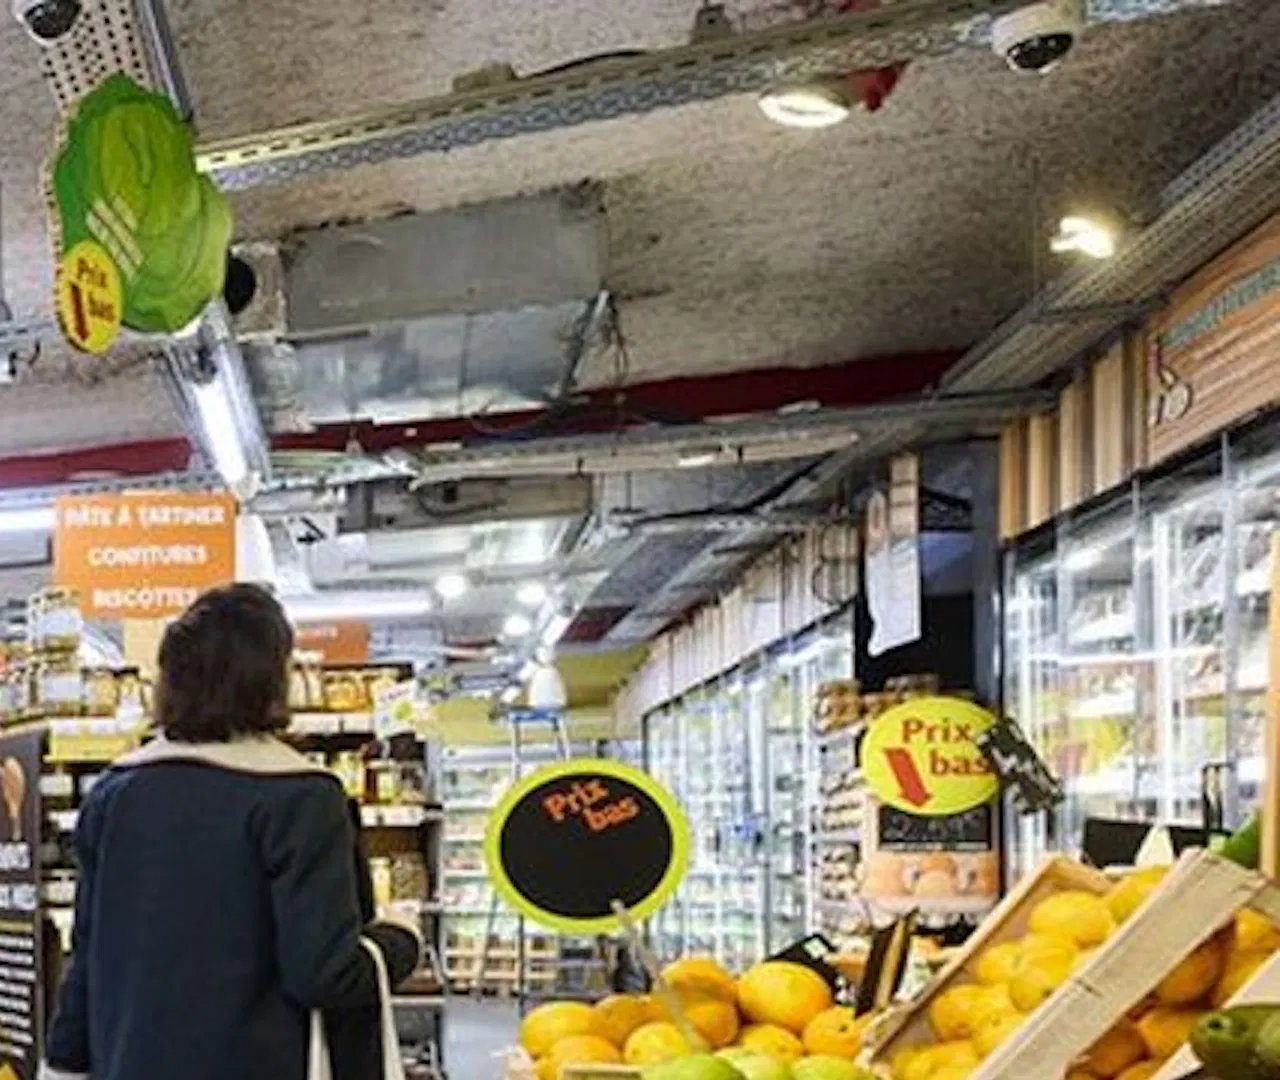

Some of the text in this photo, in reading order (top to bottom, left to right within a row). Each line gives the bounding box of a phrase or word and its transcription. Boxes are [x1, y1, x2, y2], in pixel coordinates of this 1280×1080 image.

[137, 505, 226, 526] TARTINER
[88, 545, 207, 566] CONFITURES
[901, 716, 973, 744] Prix
[928, 748, 991, 777] bas
[542, 777, 611, 822] Prix
[582, 796, 641, 832] bas
